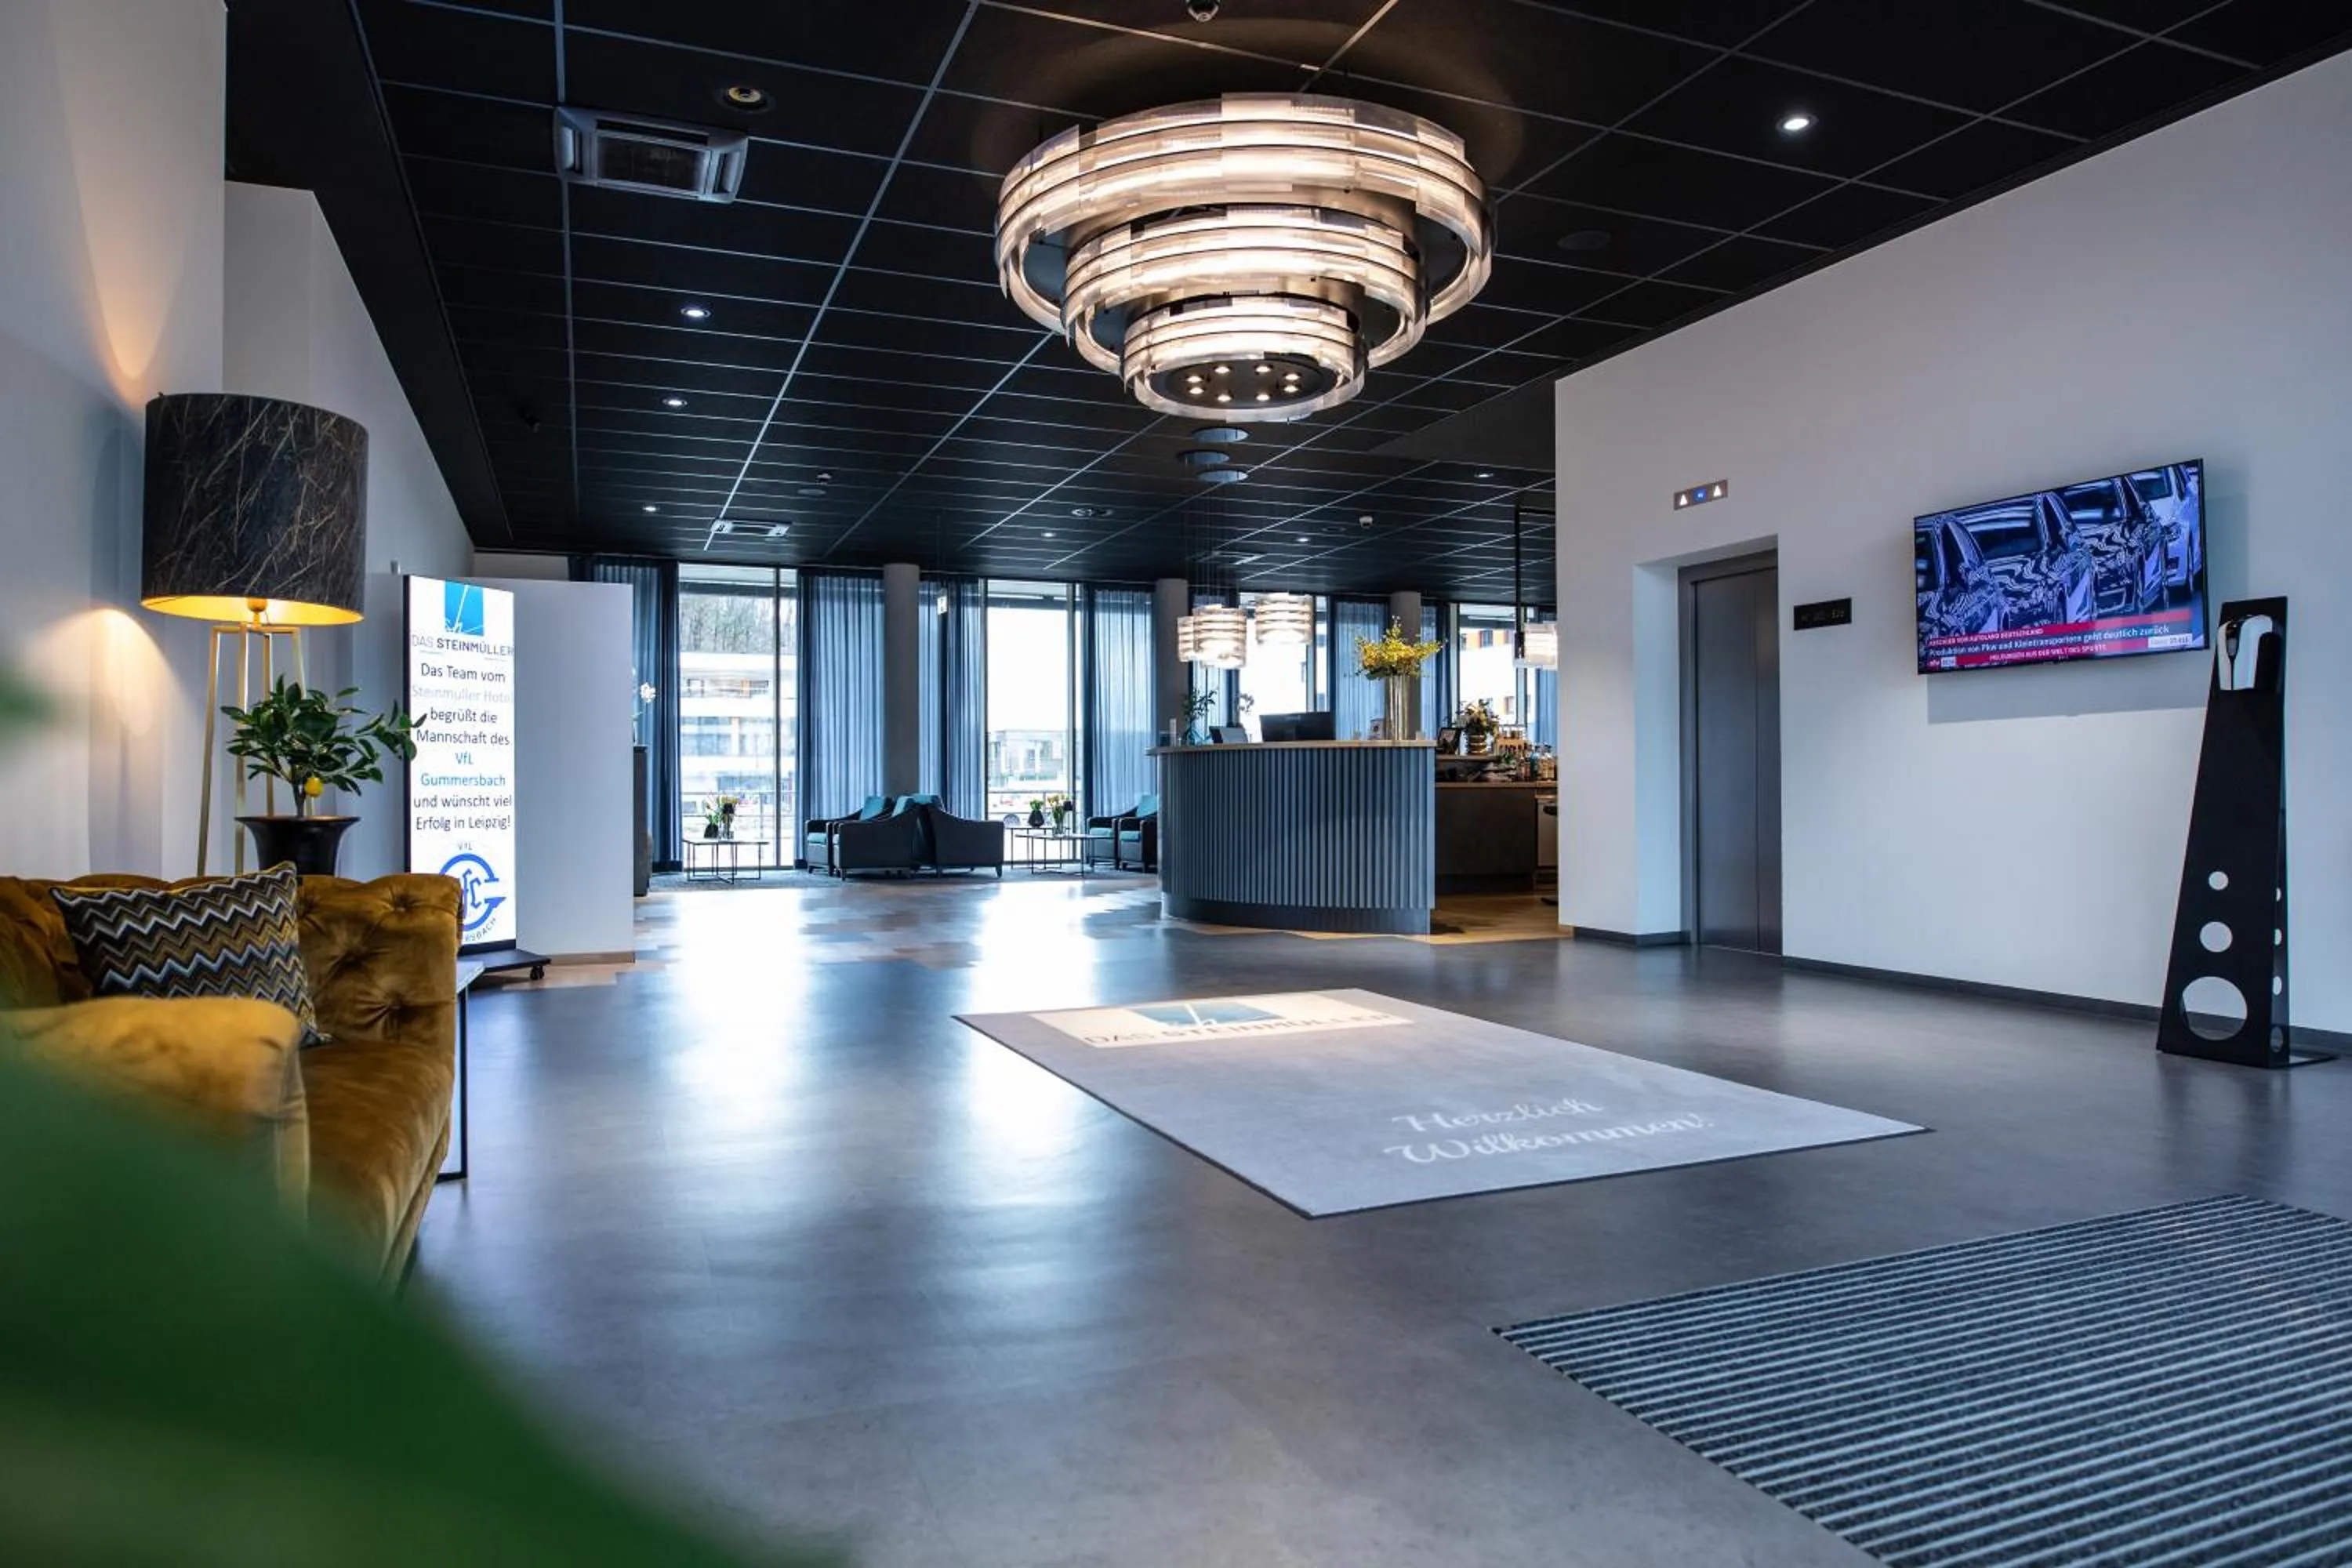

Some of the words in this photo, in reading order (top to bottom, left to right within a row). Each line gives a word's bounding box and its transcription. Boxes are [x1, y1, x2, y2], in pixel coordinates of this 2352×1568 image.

[412, 634, 434, 648] DAS
[1969, 633, 1999, 642] AUTOLAND
[2000, 629, 2044, 639] DEUTSCHLAND
[1981, 643, 1997, 652] Pkw
[1999, 641, 2013, 650] und
[2083, 633, 2102, 644] geht
[2103, 627, 2138, 641] deutlich
[2140, 624, 2169, 636] zurück
[2051, 648, 2067, 656] WELT
[420, 662, 443, 677] Das
[446, 664, 477, 680] Team
[481, 671, 506, 683] vom
[430, 707, 477, 723] begrüßt
[481, 710, 498, 724] die
[416, 729, 487, 745] Mannschaft
[490, 731, 510, 746] des
[455, 751, 474, 765] VfL
[420, 772, 506, 787] Gummersbach
[413, 795, 437, 808] und
[441, 794, 491, 808] wünscht
[493, 794, 513, 807] viel
[416, 815, 451, 832] Erfolg
[454, 816, 466, 829] in
[468, 815, 511, 831] Leipzig!
[1083, 1031, 1155, 1044] DAS
[1392, 1097, 1604, 1132] Herzlich
[1383, 1112, 1715, 1163] Willkommen!
